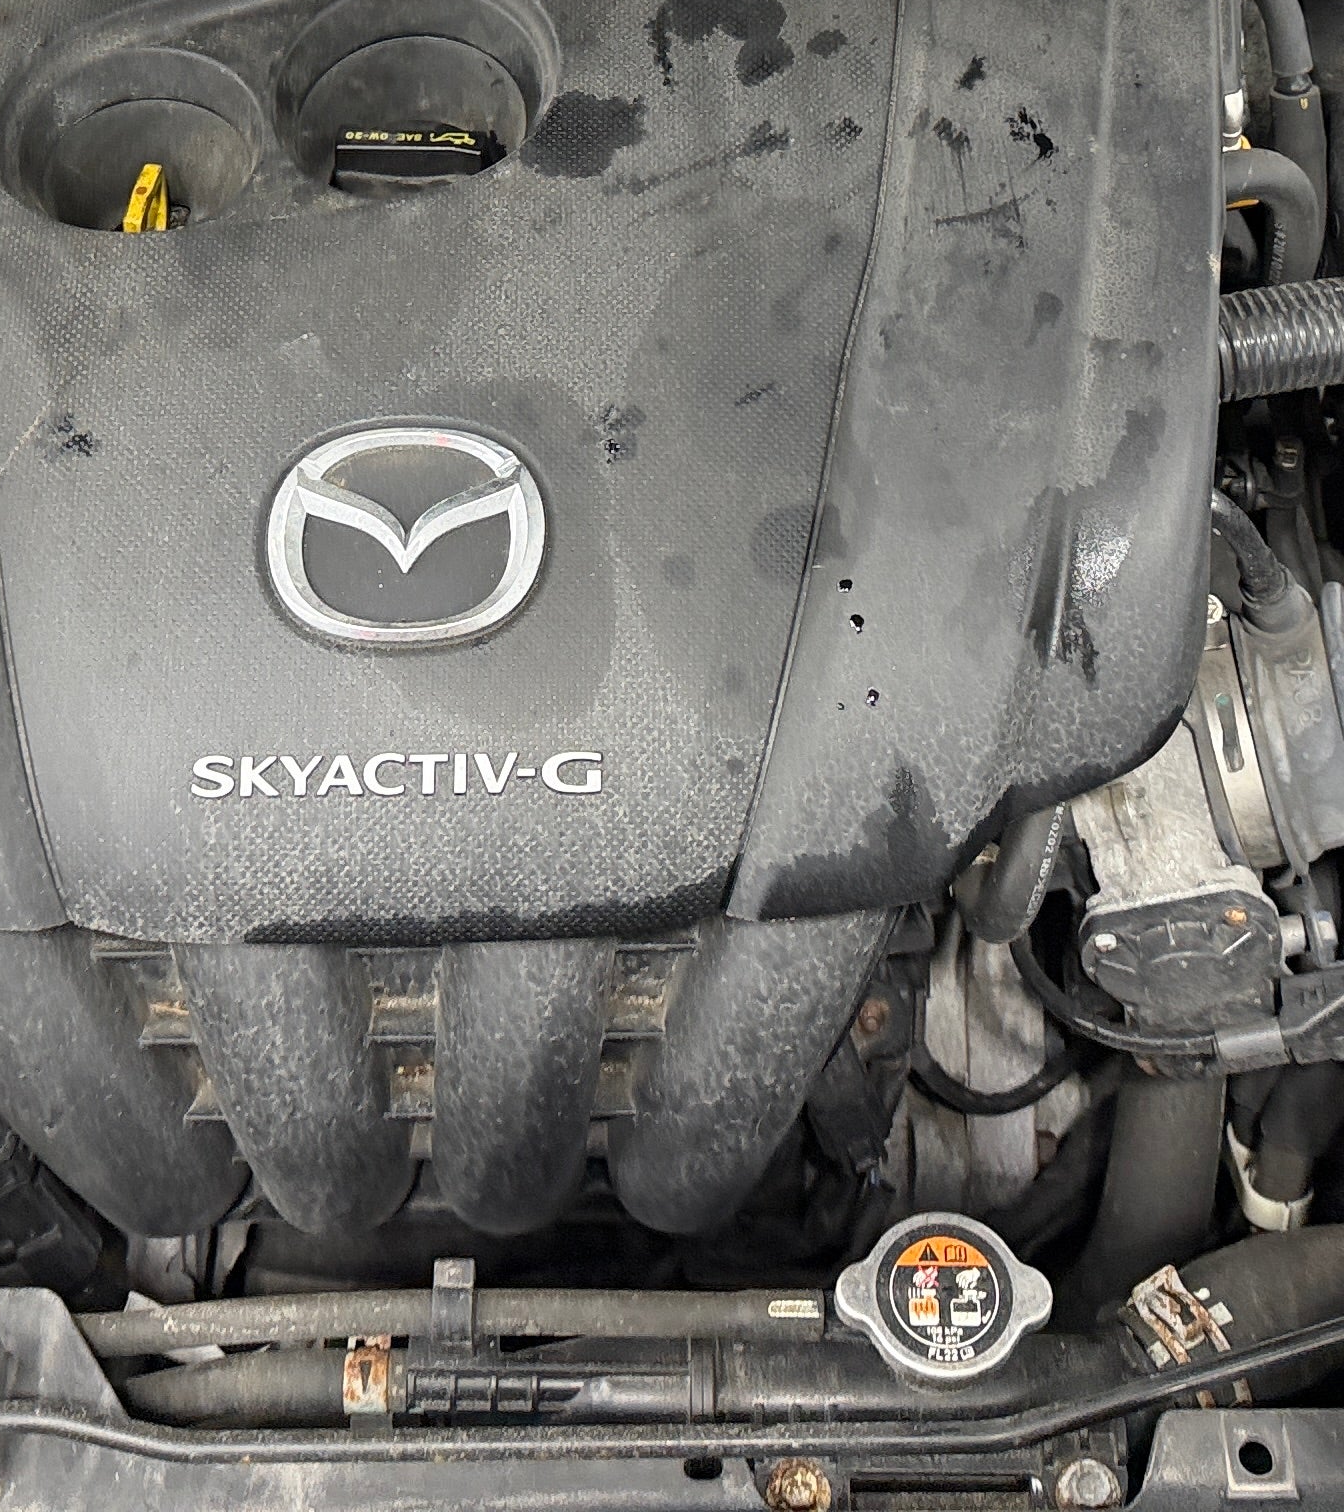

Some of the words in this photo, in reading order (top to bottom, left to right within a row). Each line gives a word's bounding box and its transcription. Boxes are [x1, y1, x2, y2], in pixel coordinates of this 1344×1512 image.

[345, 131, 389, 141] 0W-20
[395, 132, 423, 142] SAE
[190, 751, 603, 799] SKYACTIV-G
[928, 1346, 959, 1362] FL22
